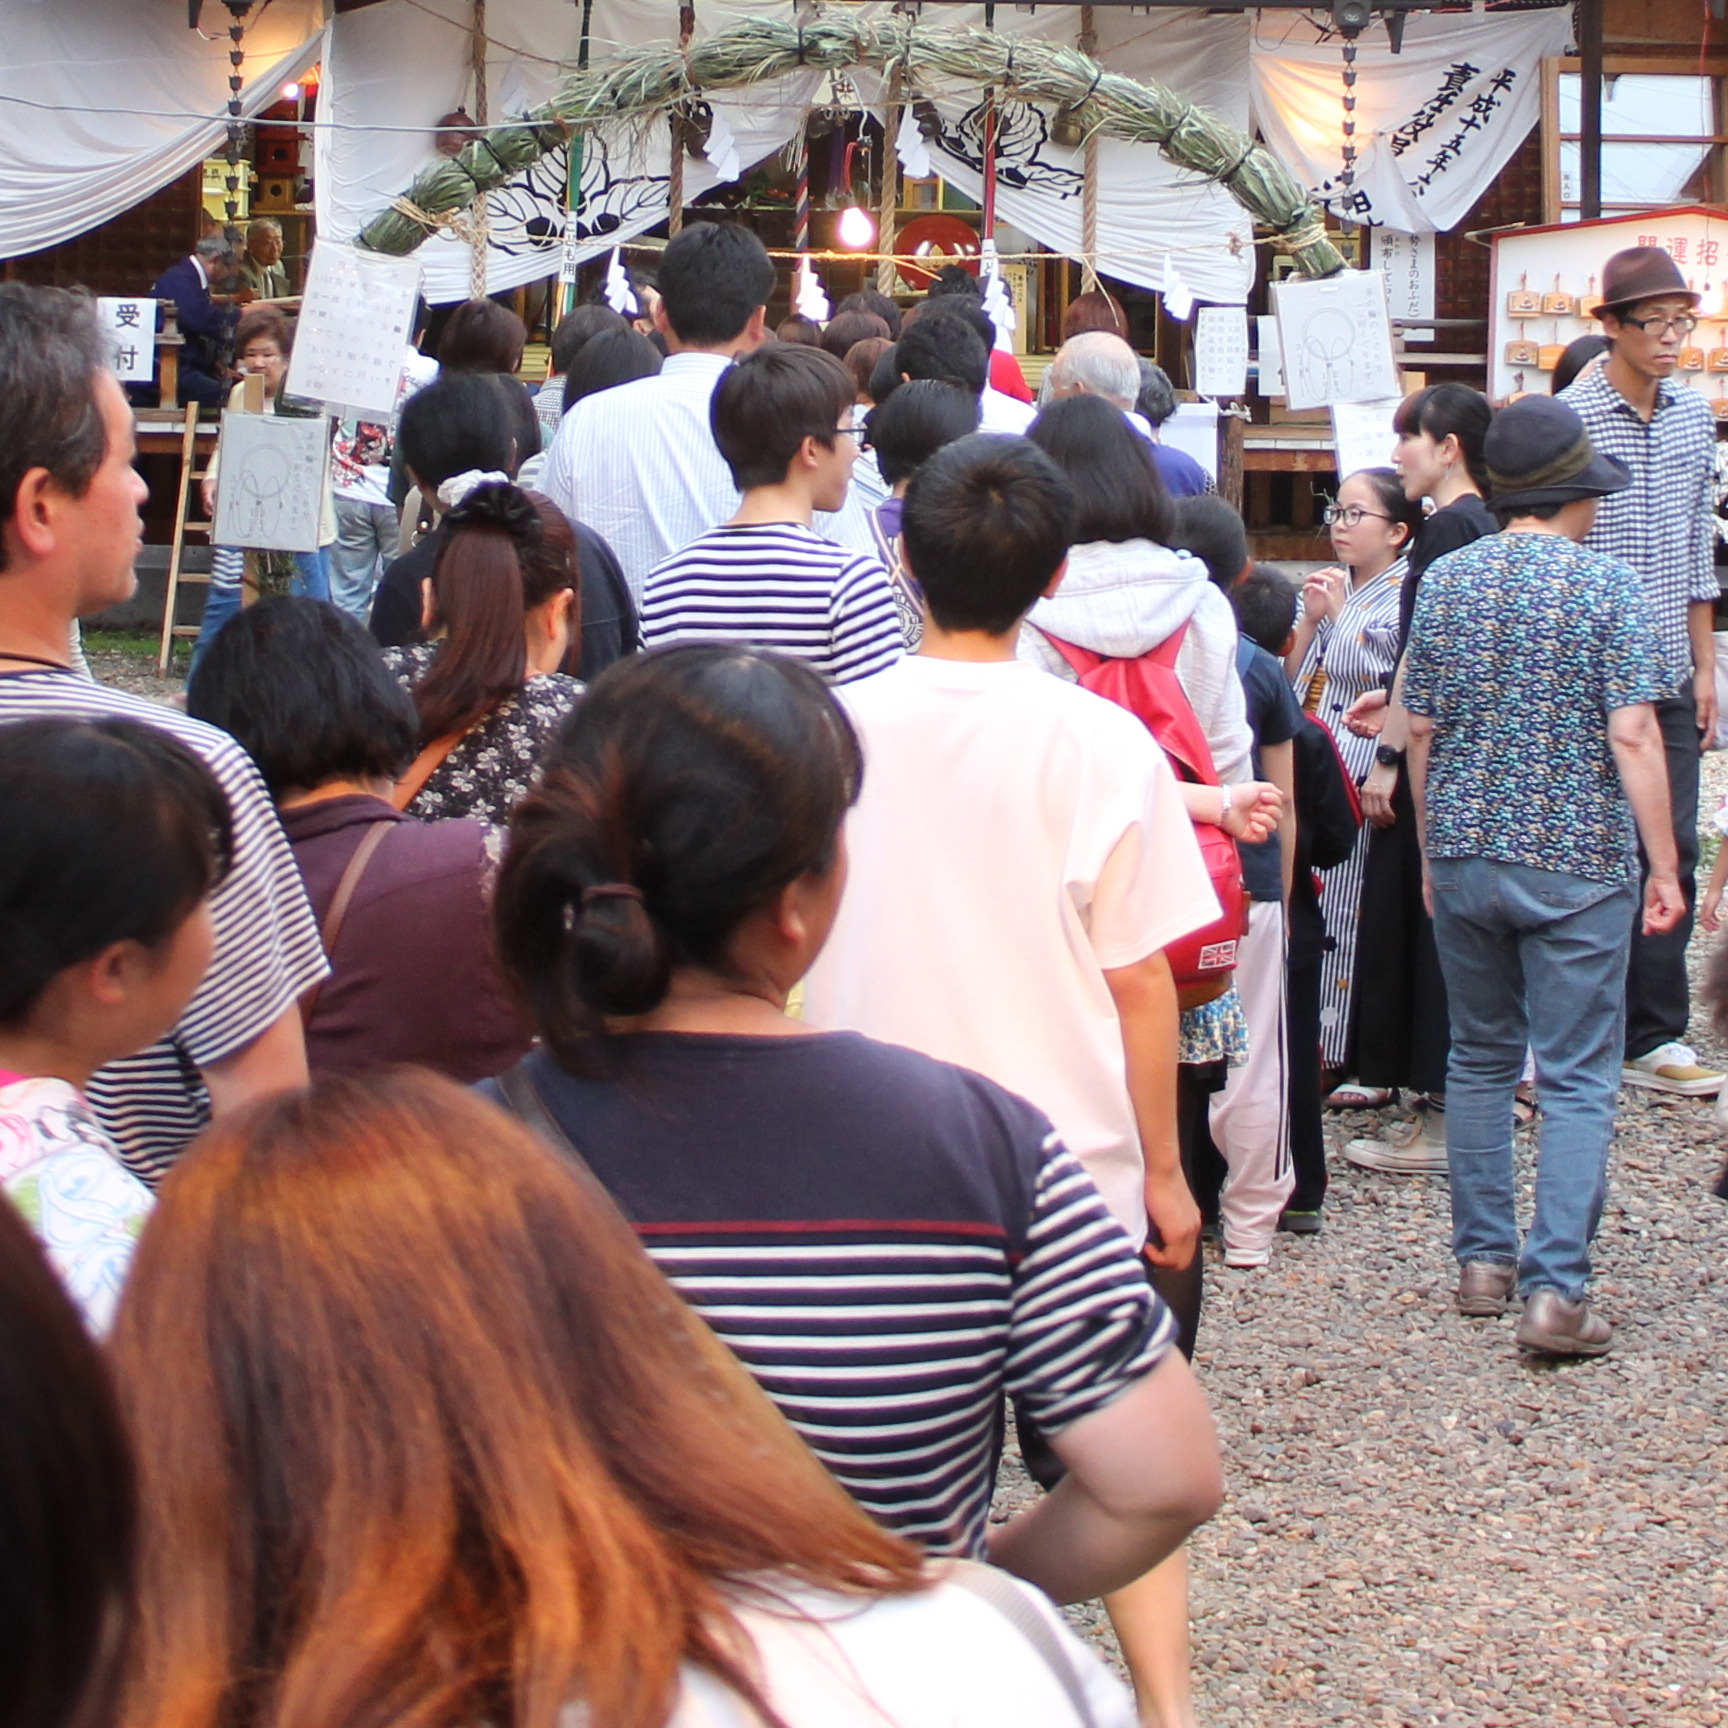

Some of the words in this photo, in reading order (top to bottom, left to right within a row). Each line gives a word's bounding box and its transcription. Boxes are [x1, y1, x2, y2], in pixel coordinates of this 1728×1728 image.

[563, 221, 576, 275] こども用
[115, 303, 140, 371] 受付
